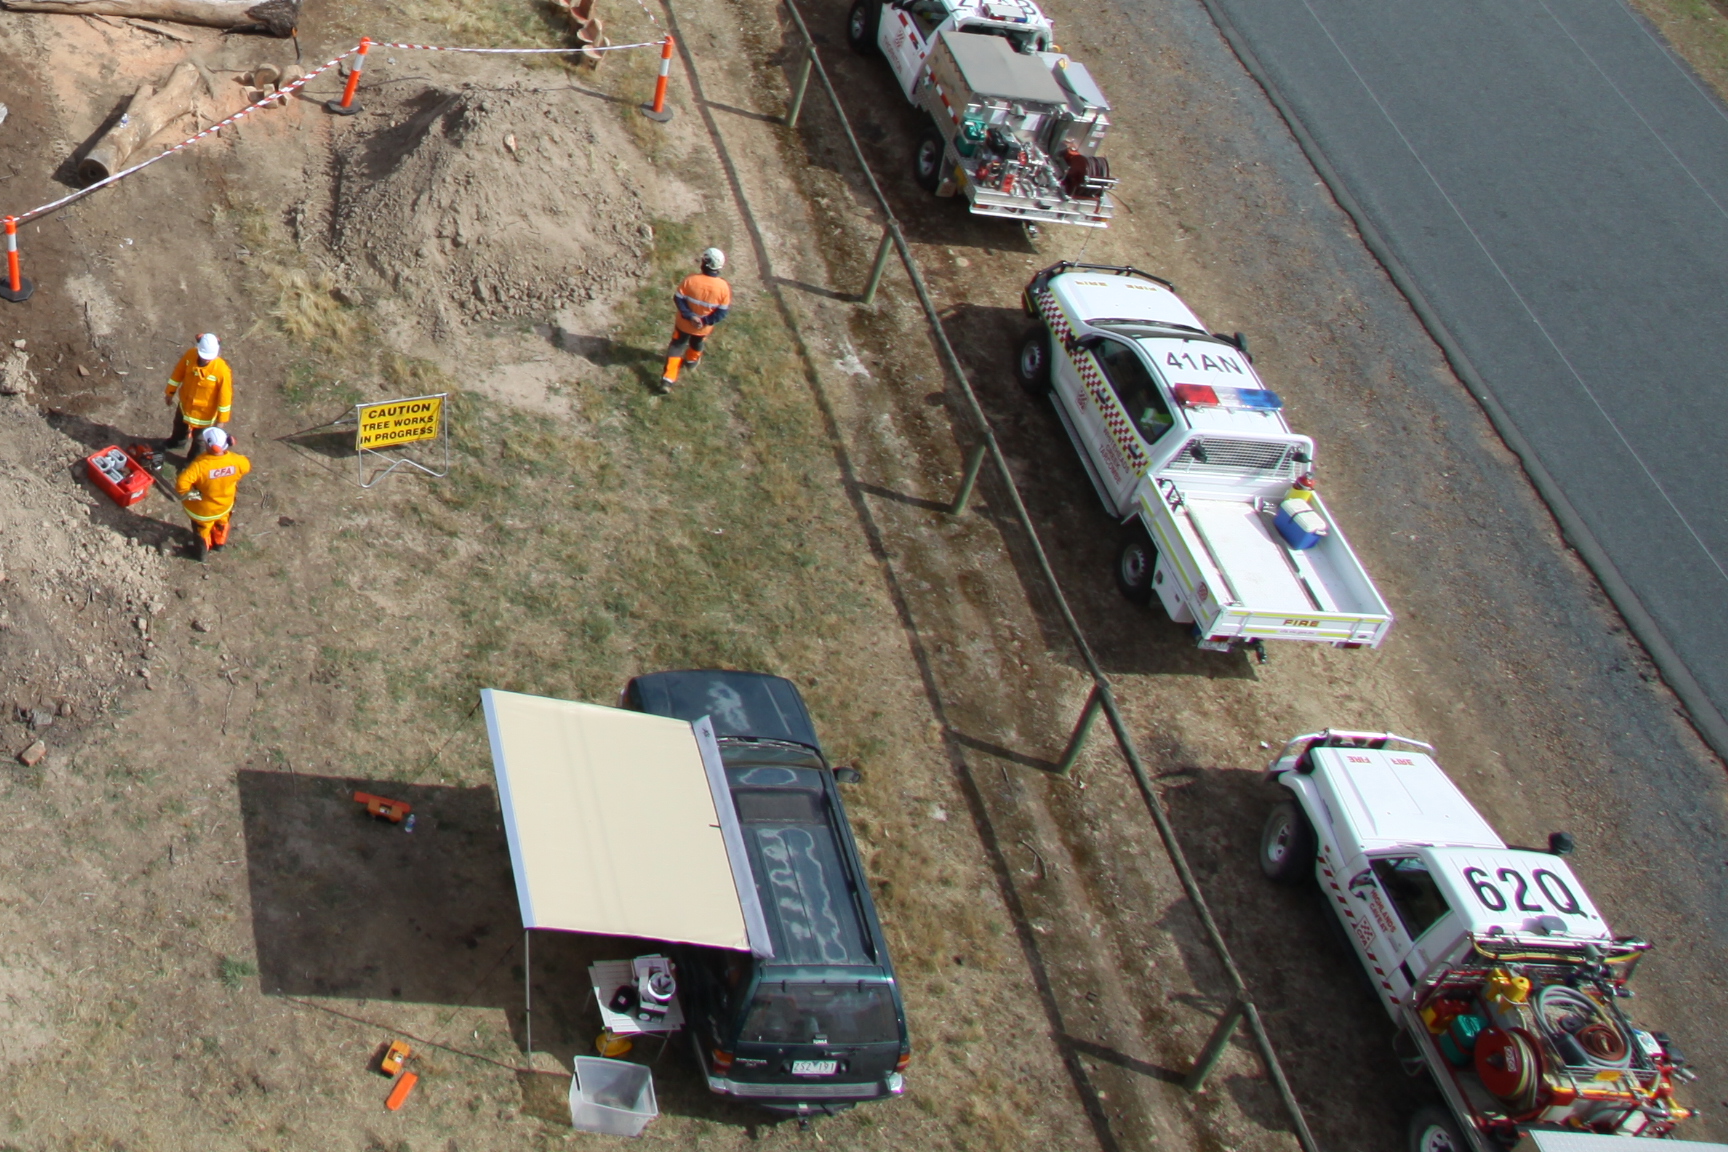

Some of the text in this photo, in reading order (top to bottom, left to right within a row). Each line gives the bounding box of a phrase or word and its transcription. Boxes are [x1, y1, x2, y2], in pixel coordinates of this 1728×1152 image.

[1166, 351, 1243, 374] 41AN
[368, 403, 431, 419] CAUTION
[362, 415, 434, 432] TREE WORKS
[360, 426, 433, 444] IN PROGRESS
[213, 467, 231, 477] CFA
[1282, 619, 1320, 627] FIRE
[1347, 755, 1372, 764] FIRE
[1463, 866, 1588, 919] 62Q
[1370, 889, 1397, 933] HIGHLANDS
[1370, 903, 1388, 933] CAVEAT
[1356, 929, 1368, 947] CFA
